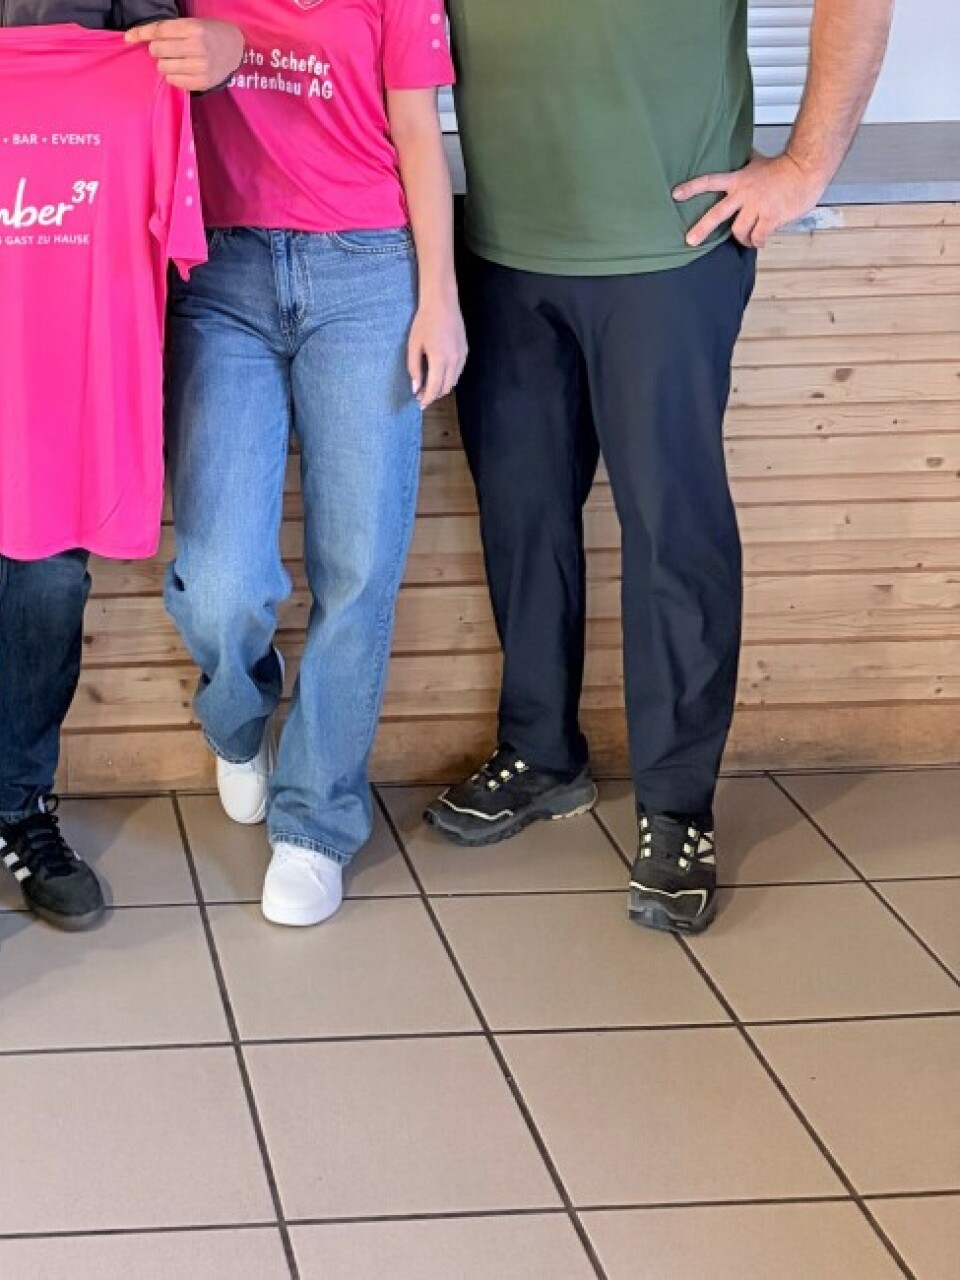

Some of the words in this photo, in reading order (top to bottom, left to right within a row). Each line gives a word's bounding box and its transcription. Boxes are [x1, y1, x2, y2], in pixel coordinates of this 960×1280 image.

[270, 48, 330, 76] Schefer
[308, 78, 333, 100] AG
[12, 133, 38, 145] BAR
[52, 133, 101, 146] EVENTS
